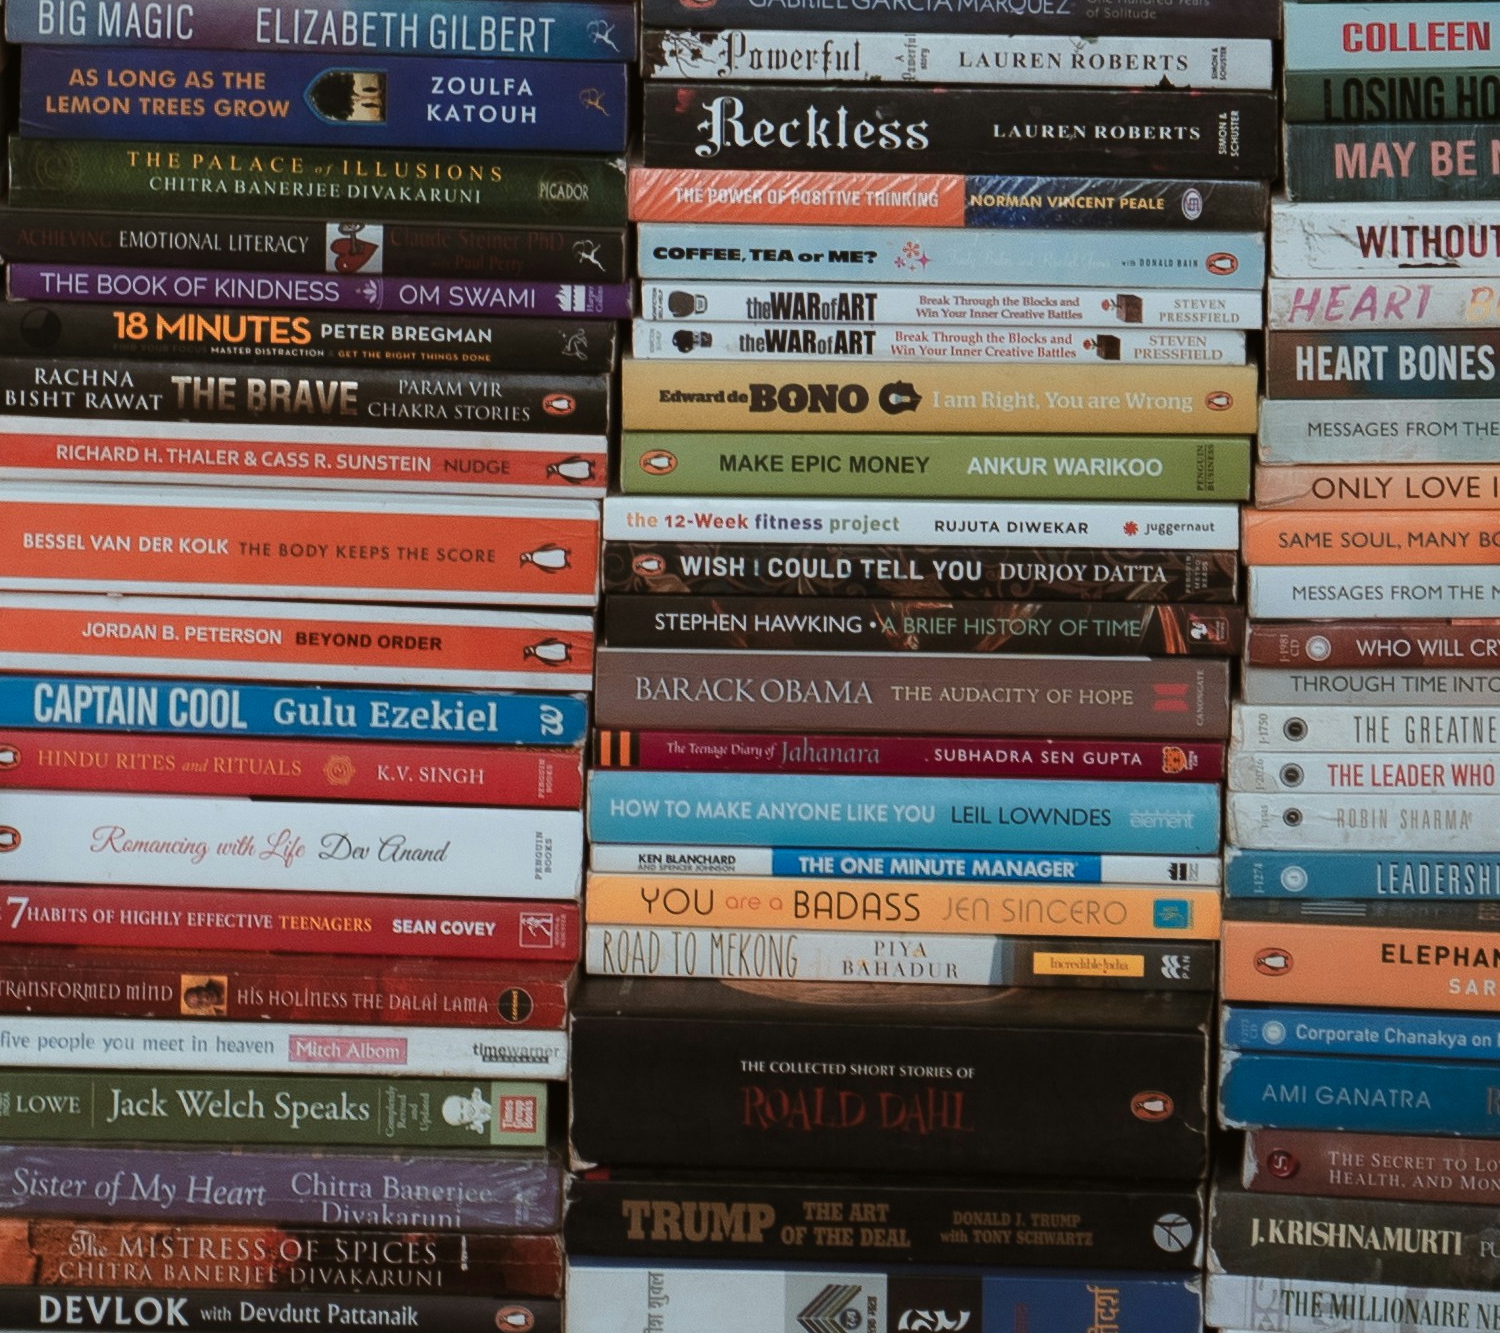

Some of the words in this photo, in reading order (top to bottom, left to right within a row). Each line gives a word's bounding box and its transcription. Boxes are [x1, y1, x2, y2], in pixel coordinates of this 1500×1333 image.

[254, 5, 421, 51] ELIZABETH
[428, 7, 556, 55] GILBERT
[967, 455, 1049, 478] ANKUR
[1055, 455, 1163, 480] WARIKOO
[34, 684, 160, 728] CAPTAIN
[167, 687, 247, 731] COOL
[273, 696, 361, 731] Gulu
[370, 698, 499, 736] Ezekiel
